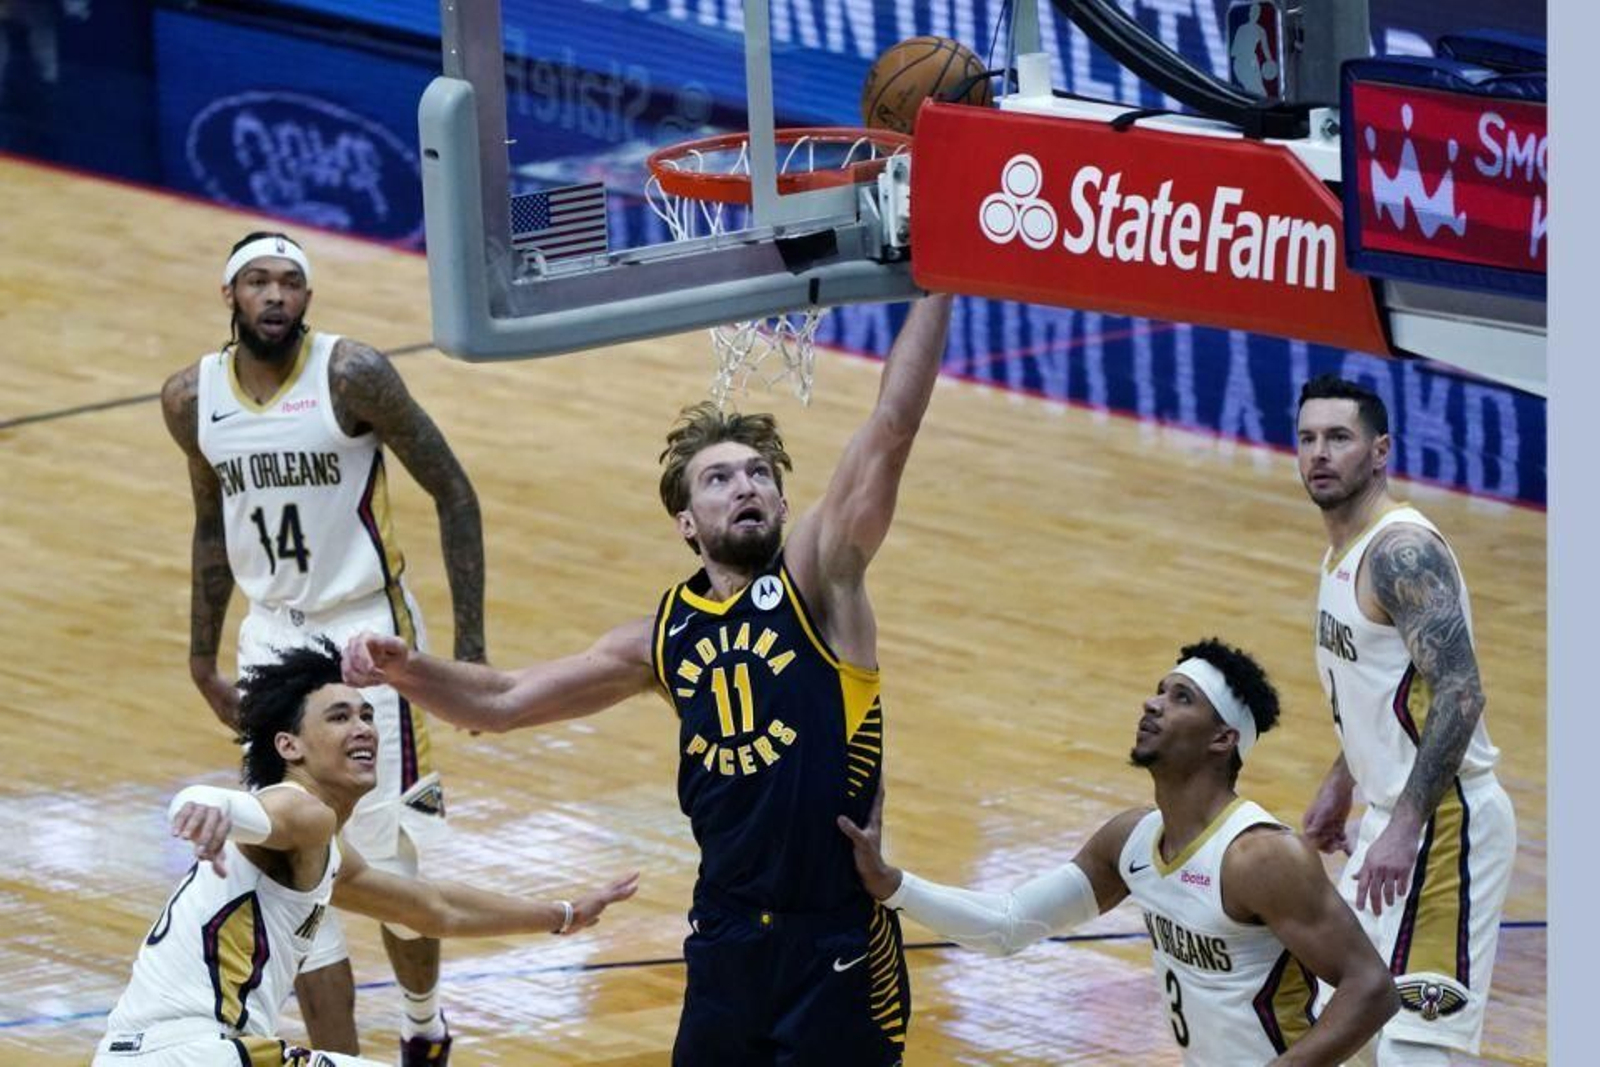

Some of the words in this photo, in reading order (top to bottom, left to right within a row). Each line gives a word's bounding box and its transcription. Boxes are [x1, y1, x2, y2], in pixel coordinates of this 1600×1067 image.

[250, 451, 341, 490] ORLEANS
[251, 503, 311, 576] 14
[676, 622, 797, 698] INDIANA
[711, 662, 754, 738] 11
[686, 719, 797, 776] PACERS
[1181, 870, 1211, 886] ibotta
[1165, 967, 1190, 1048] 3
